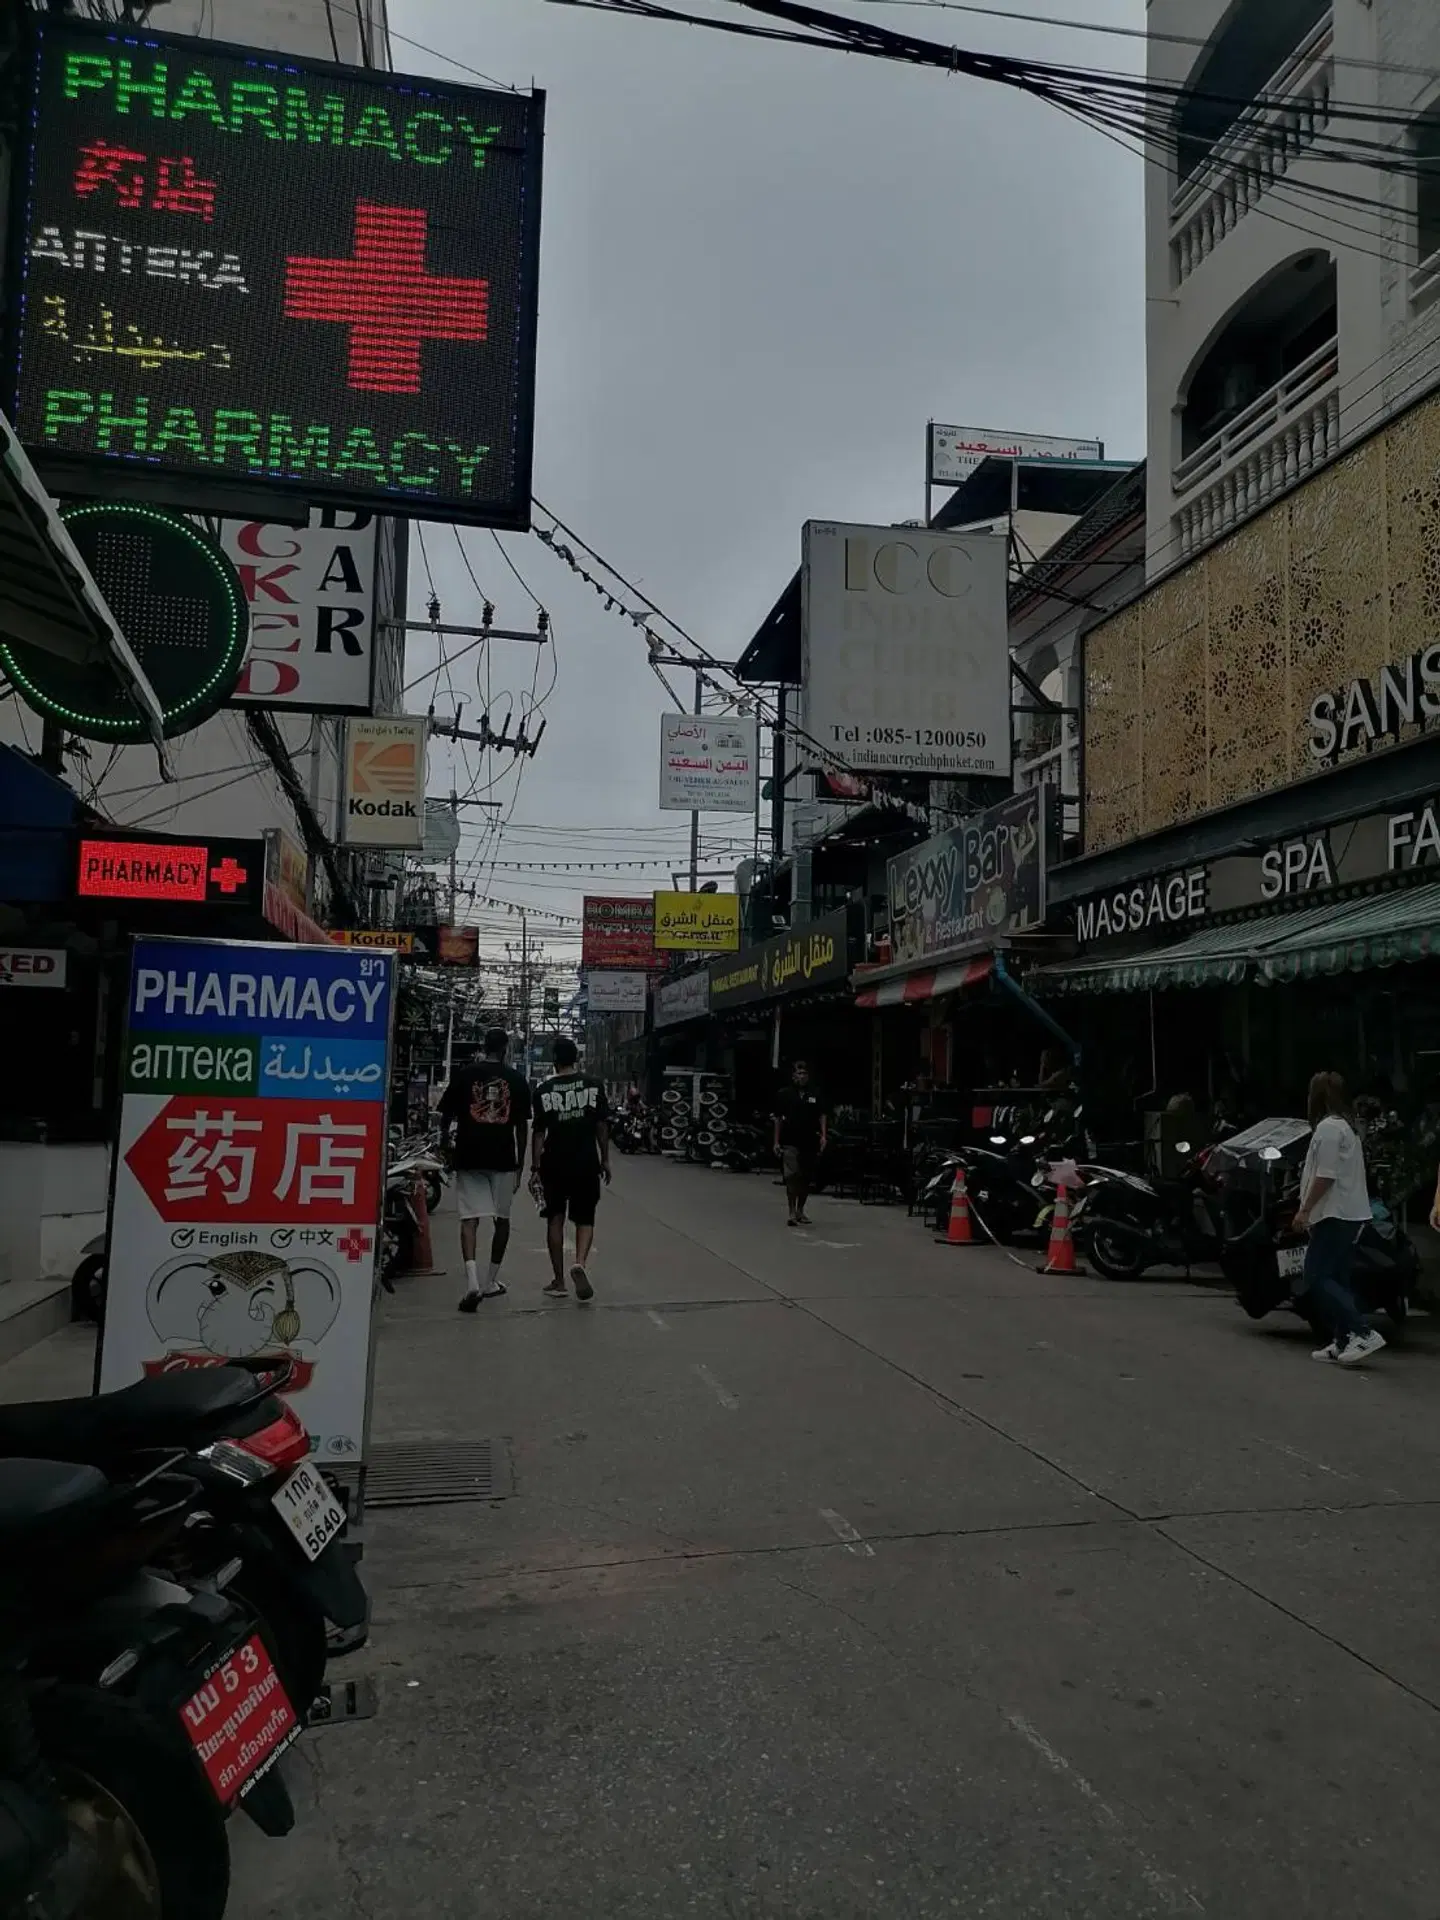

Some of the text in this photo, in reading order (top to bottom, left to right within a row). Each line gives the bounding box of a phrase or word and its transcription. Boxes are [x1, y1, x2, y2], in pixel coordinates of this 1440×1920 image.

[63, 52, 502, 168] PHARMACY
[31, 227, 250, 293] АПТЕКА
[44, 389, 491, 496] PHARMACY
[830, 724, 860, 742] Tel
[349, 799, 417, 817] Kodak
[87, 858, 202, 885] PHARMACY
[963, 823, 1009, 892] Bar
[1260, 838, 1332, 899] SPA
[935, 907, 985, 941] Restaurant
[1076, 870, 1206, 943] MASSAGE
[350, 931, 408, 946] Kodak
[360, 958, 385, 977] ยา
[134, 968, 386, 1023] PHARMACY
[130, 1044, 254, 1082] аптека
[540, 1087, 599, 1113] BRAVE
[163, 1110, 368, 1205] 药店
[199, 1231, 258, 1247] English
[299, 1229, 334, 1246] 中文
[306, 1508, 341, 1553] 5640
[219, 1660, 240, 1693] 5
[240, 1644, 259, 1674] 3
